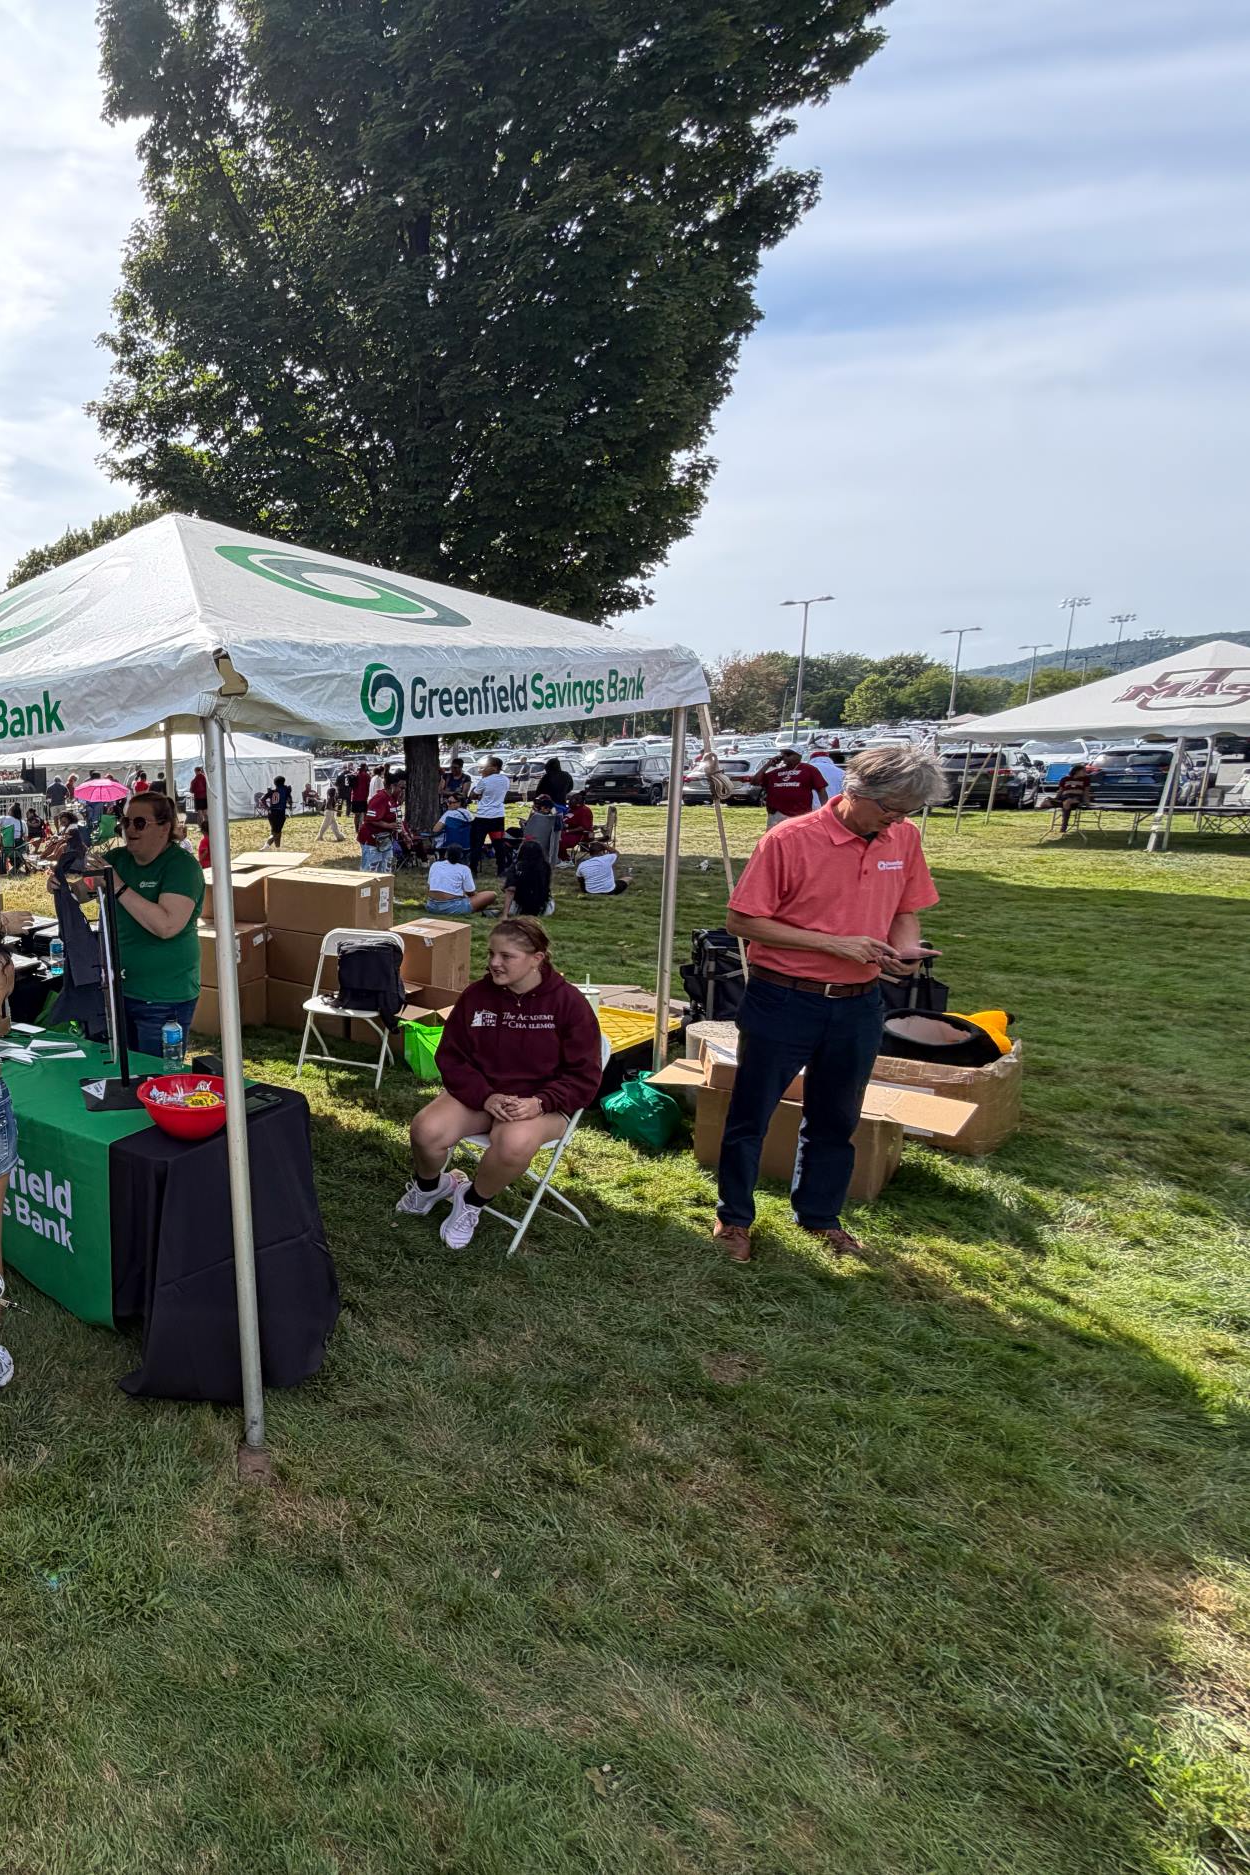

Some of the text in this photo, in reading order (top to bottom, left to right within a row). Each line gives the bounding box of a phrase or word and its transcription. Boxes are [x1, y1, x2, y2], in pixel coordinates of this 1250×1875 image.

[411, 668, 647, 720] Greenfield Savings Bank
[502, 1012, 516, 1020] The
[9, 1158, 73, 1220] field
[14, 1193, 75, 1254] Bank
